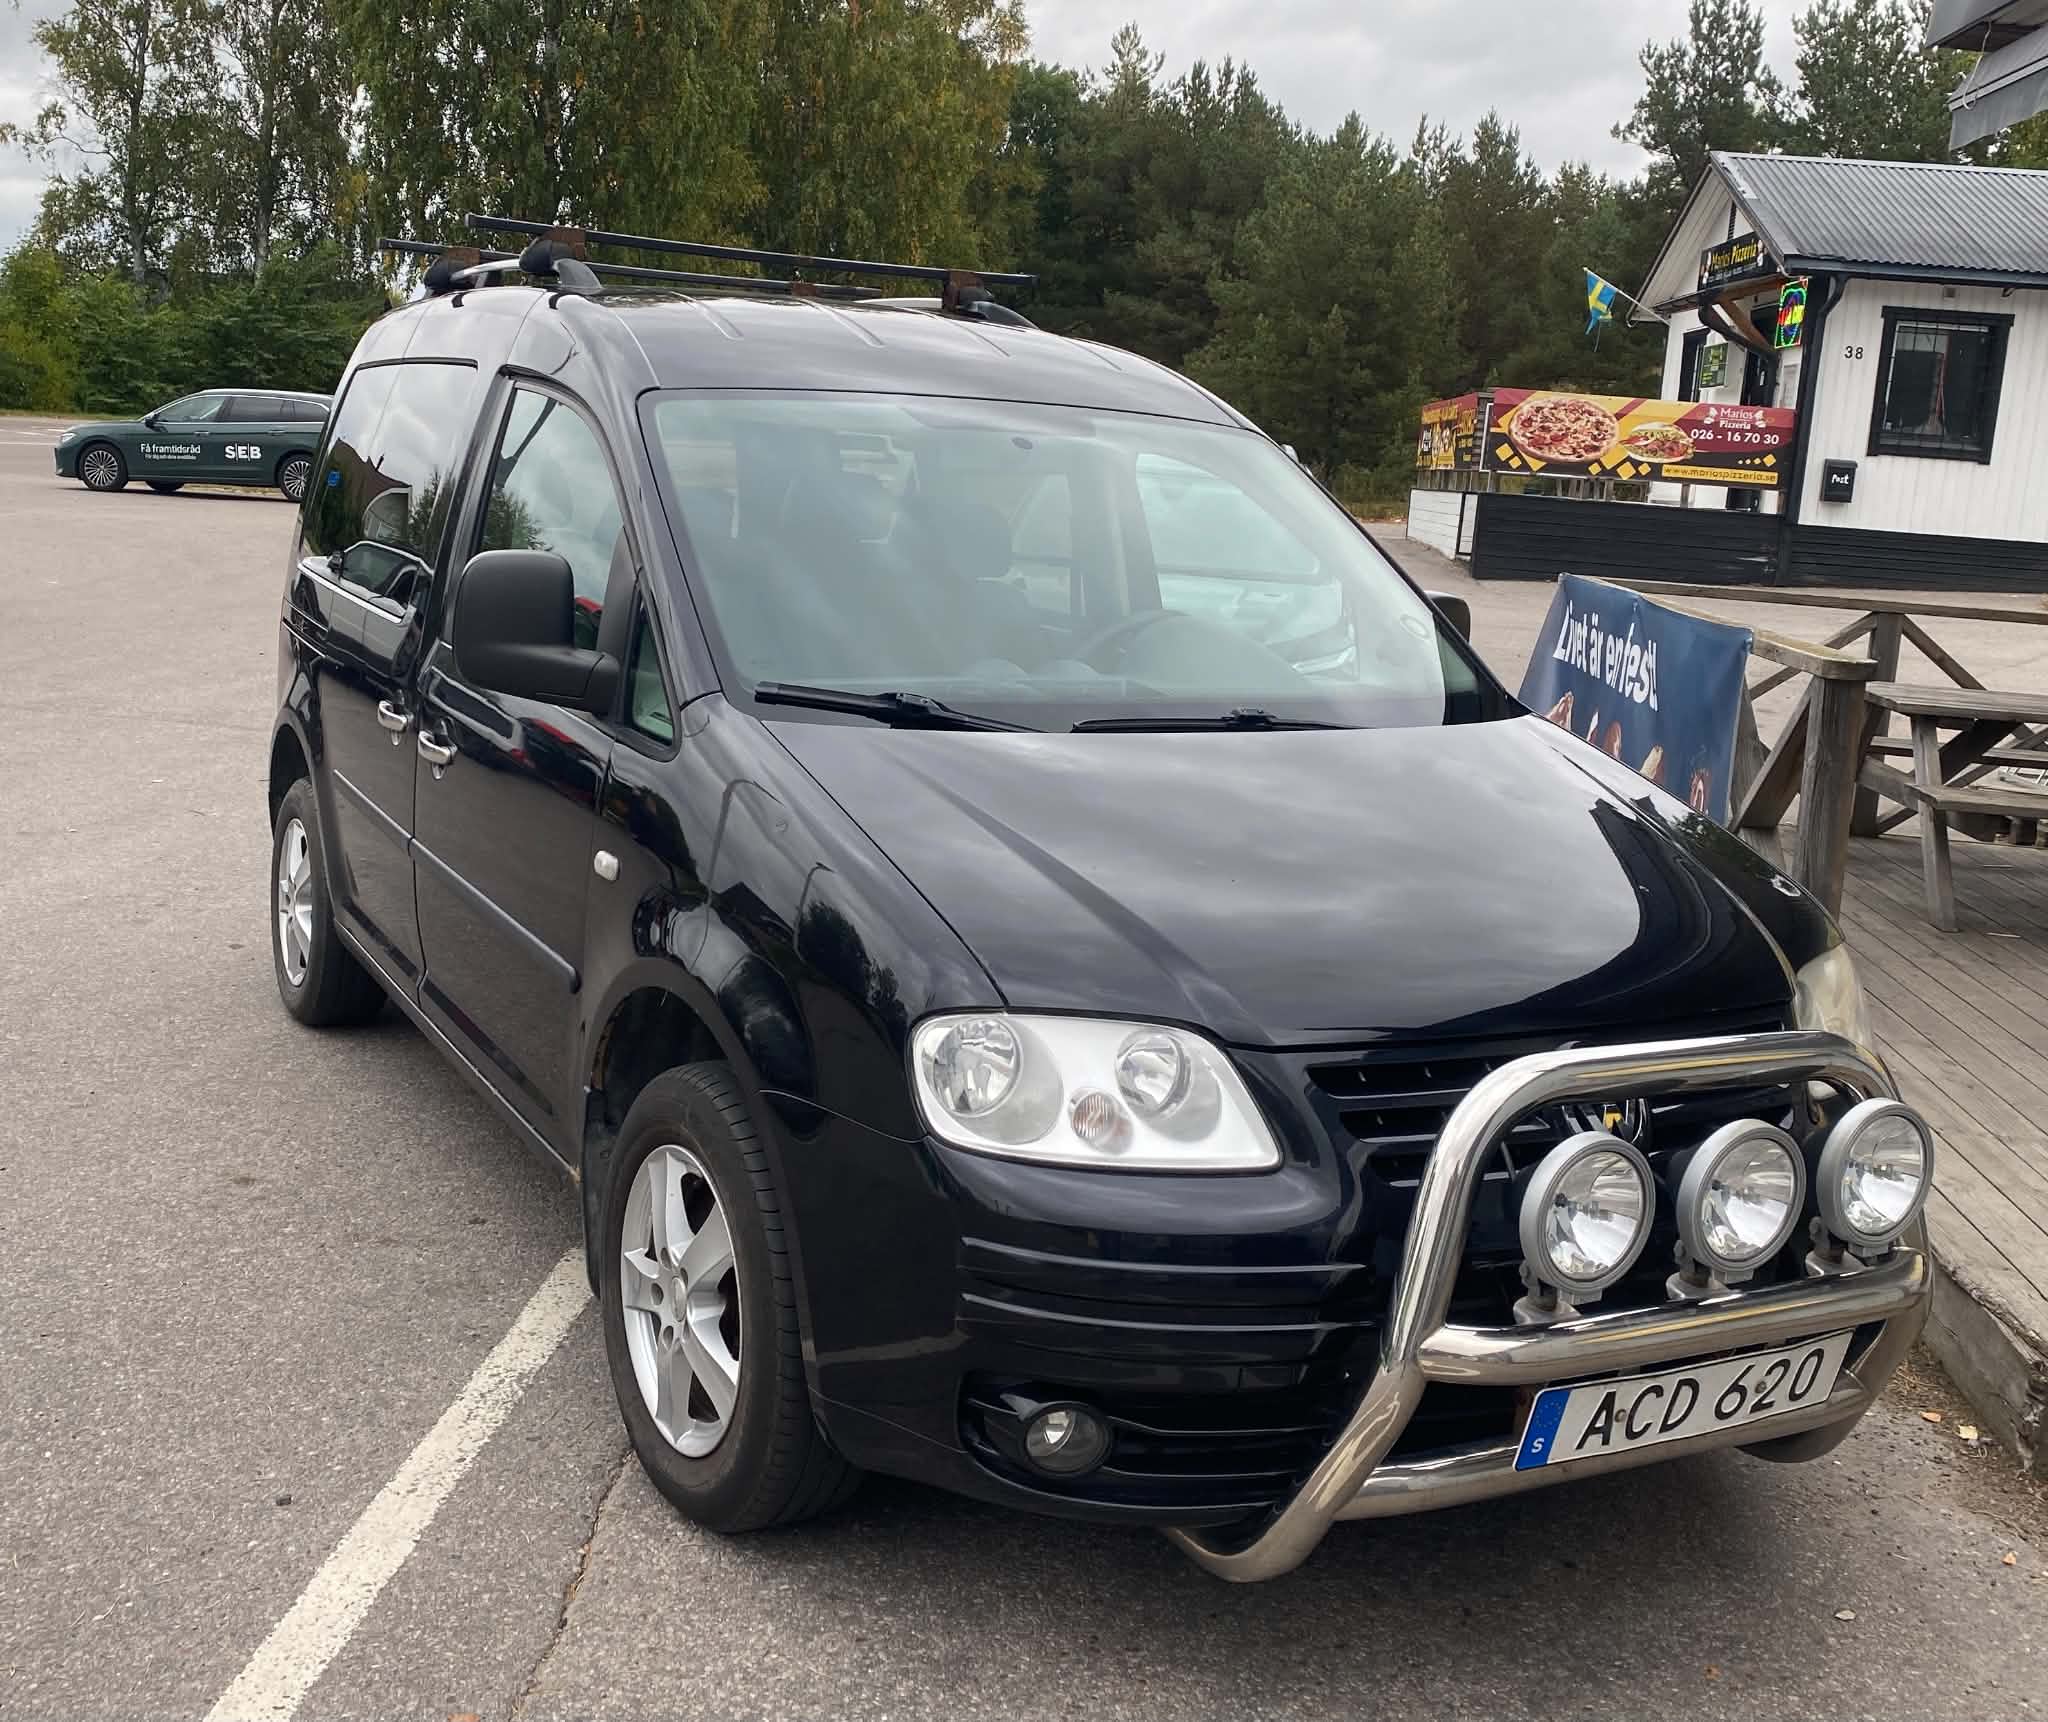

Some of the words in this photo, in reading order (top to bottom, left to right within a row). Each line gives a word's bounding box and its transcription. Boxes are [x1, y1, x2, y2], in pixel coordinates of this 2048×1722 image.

[1844, 345, 1864, 360] 38
[1720, 408, 1753, 419] Marios
[1719, 420, 1751, 430] Pizzeria
[1690, 429, 1714, 440] 026
[1727, 431, 1741, 442] 16
[1744, 432, 1761, 443] 70
[1763, 434, 1780, 445] 30
[140, 443, 151, 453] Få
[152, 443, 201, 454] framtidsråd
[224, 444, 262, 460] SEB
[1664, 467, 1776, 482] www.mariospizzeria.se
[1552, 600, 1588, 673] Livet
[1589, 612, 1604, 679] är
[1575, 1378, 1700, 1450] ACD
[1713, 1347, 1825, 1421] 620
[1531, 1437, 1545, 1454] S
